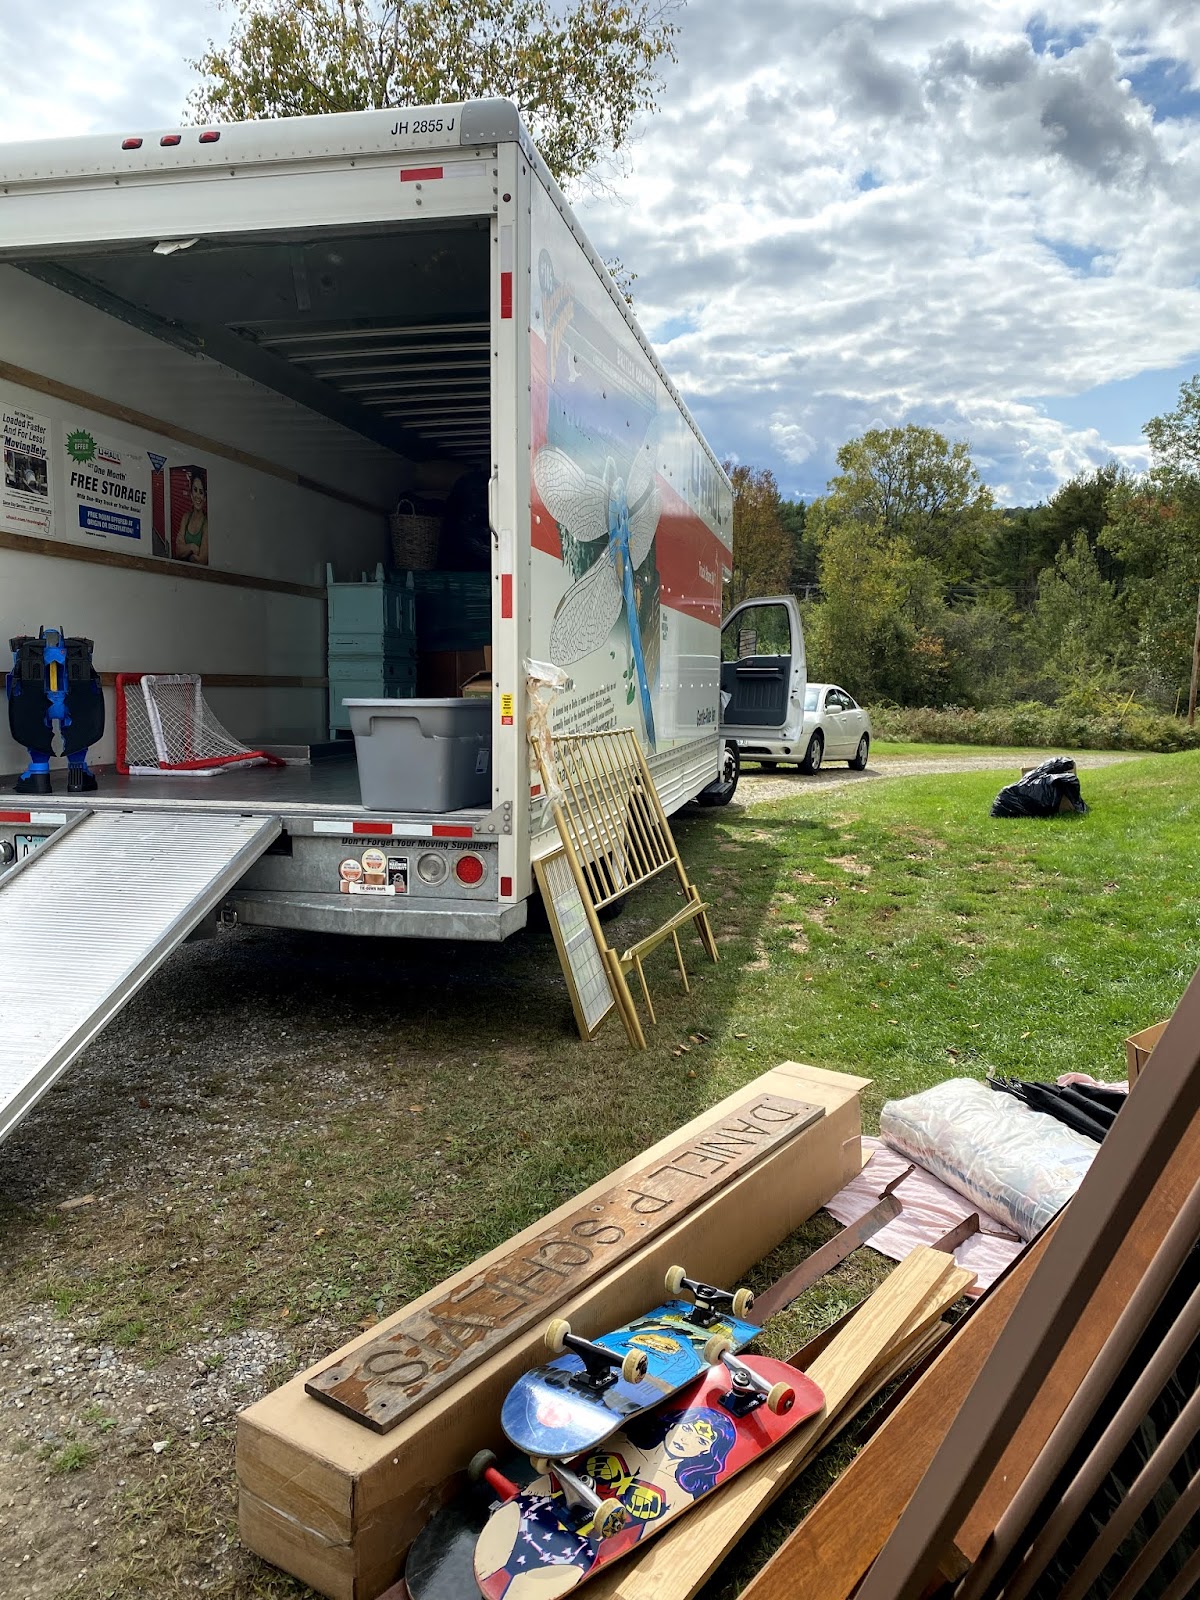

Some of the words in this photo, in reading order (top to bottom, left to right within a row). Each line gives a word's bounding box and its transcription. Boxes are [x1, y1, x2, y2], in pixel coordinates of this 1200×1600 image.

[391, 122, 409, 135] JH
[413, 119, 443, 133] 2855
[447, 118, 455, 131] J
[2, 413, 26, 428] Loaded
[26, 420, 46, 434] Faster
[4, 425, 16, 436] And
[17, 428, 28, 439] For
[29, 431, 45, 444] Less!
[94, 465, 105, 476] One
[70, 472, 99, 492] FREE
[102, 480, 147, 505] STORAGE
[341, 837, 366, 846] Don't
[367, 838, 394, 847] Forget
[396, 839, 415, 847] Your
[418, 840, 448, 850] Moving
[451, 842, 492, 850] Supplies!
[648, 1104, 800, 1180] DANIEL
